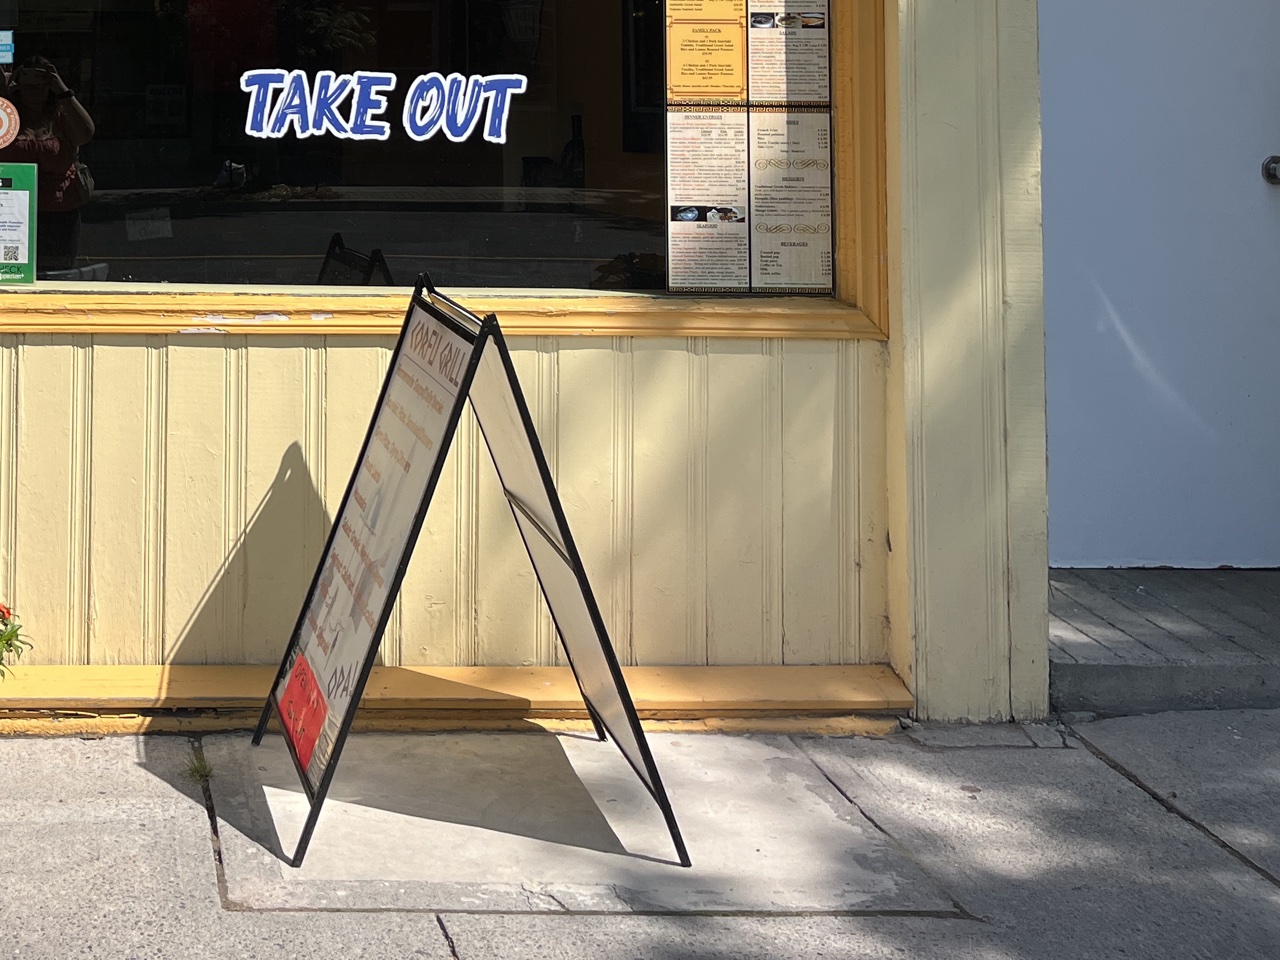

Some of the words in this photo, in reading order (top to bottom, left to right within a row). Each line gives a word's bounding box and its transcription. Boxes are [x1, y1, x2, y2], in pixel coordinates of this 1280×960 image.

[240, 69, 396, 140] TAKE
[403, 73, 527, 144] OUT
[409, 319, 441, 367] CORFU
[440, 341, 466, 387] GRILL
[327, 660, 360, 700] OPA!
